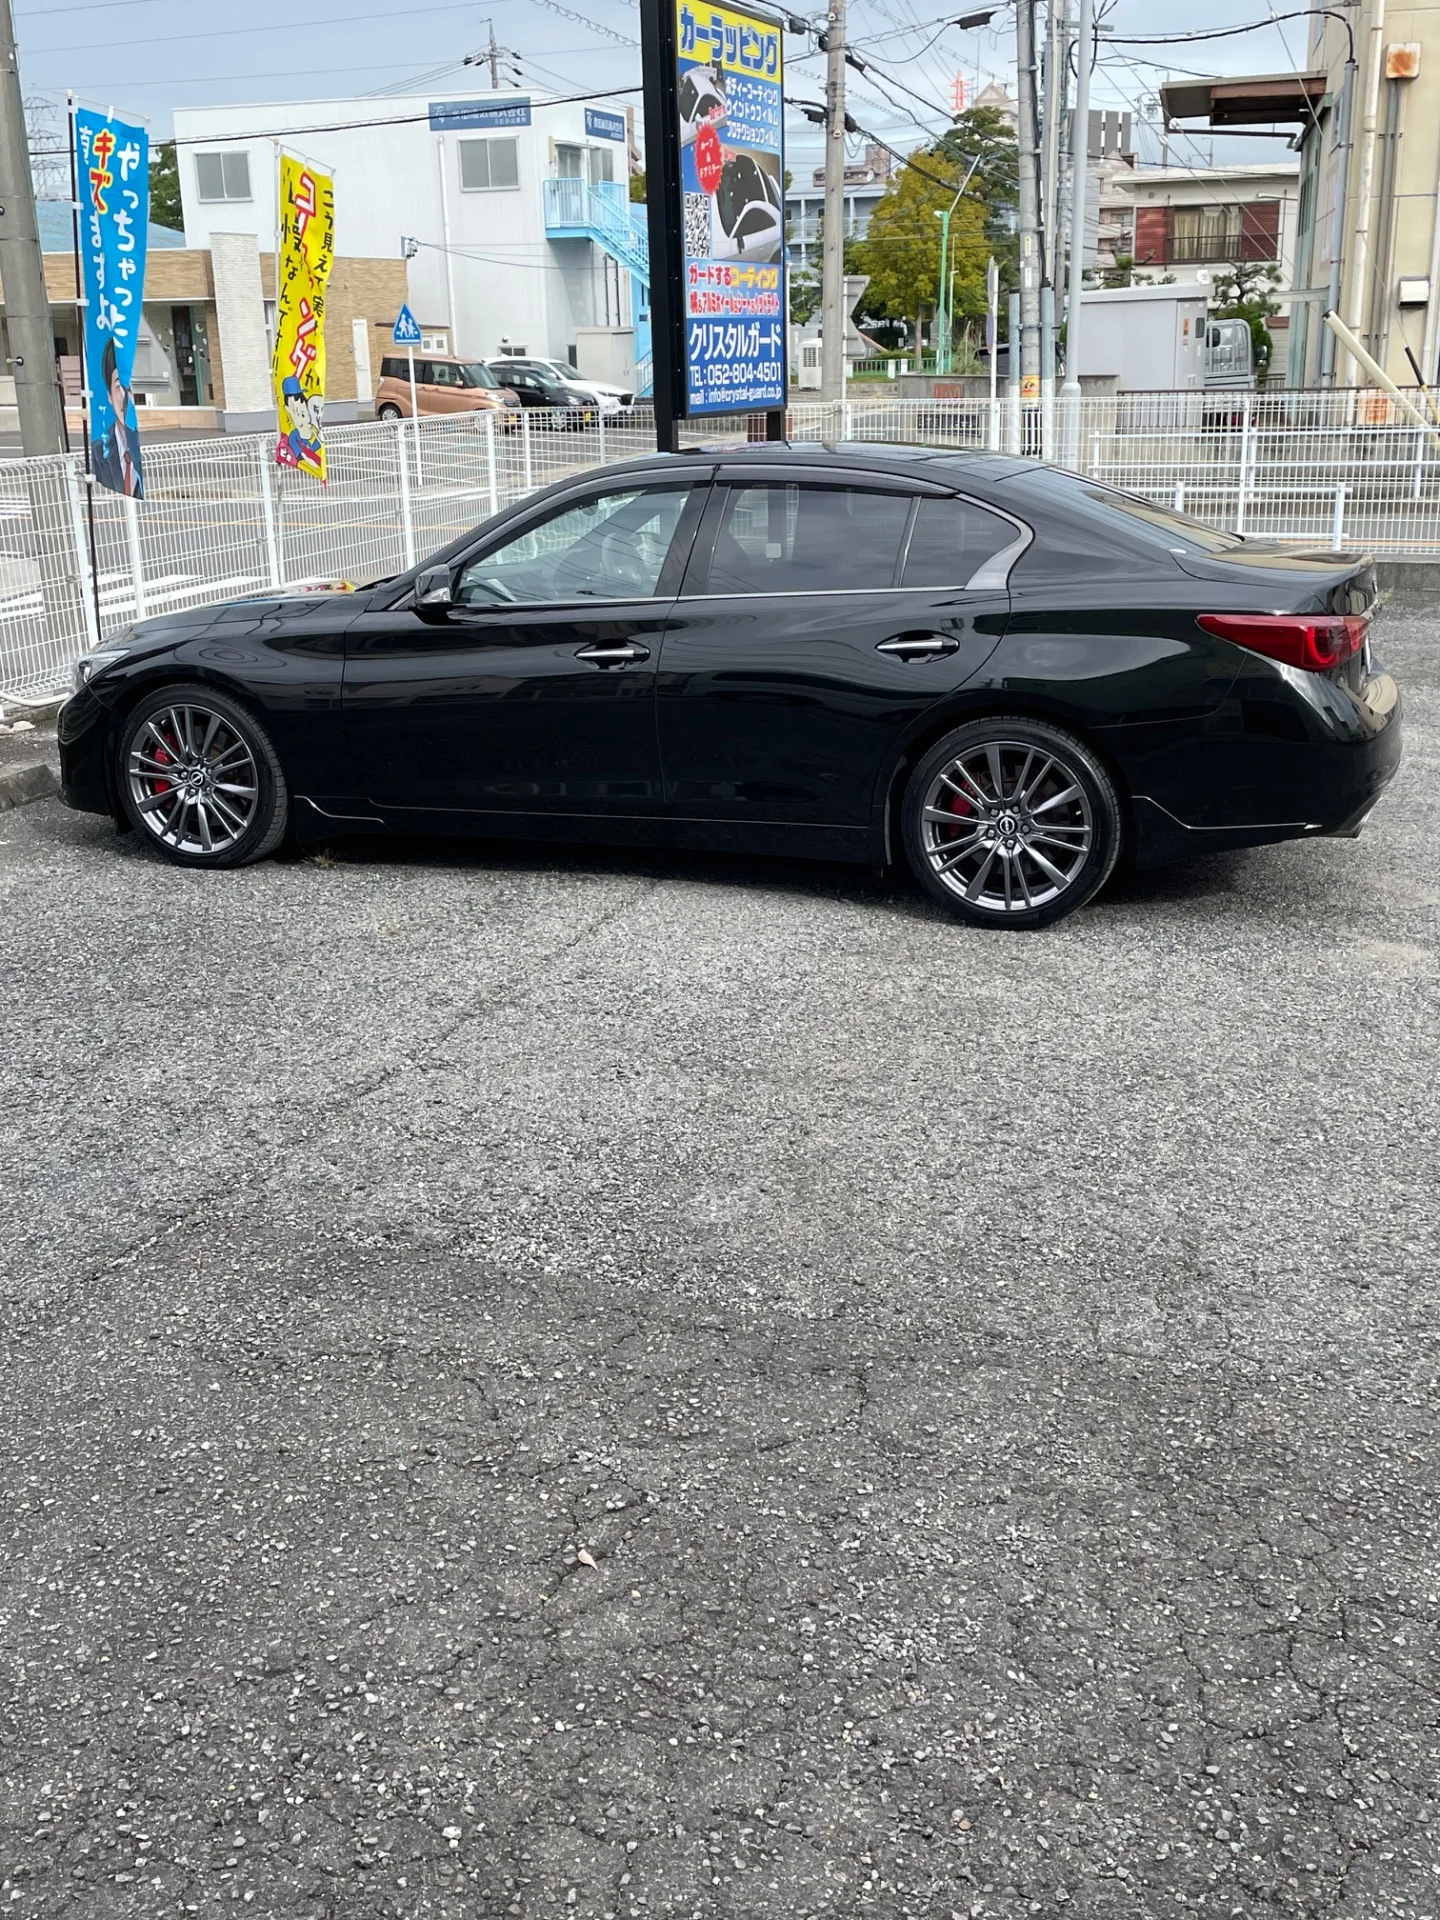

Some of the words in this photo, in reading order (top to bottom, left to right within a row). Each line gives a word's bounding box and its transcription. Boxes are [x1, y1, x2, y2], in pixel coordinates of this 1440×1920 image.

[680, 6, 778, 77] カーラッピング
[725, 76, 778, 106] ボディーコーティング
[727, 120, 778, 147] プロテクションフィルム
[90, 128, 117, 215] キズ
[699, 164, 720, 179] ドアミラー
[110, 141, 141, 349] やっちゃった
[689, 321, 782, 362] クリスタルガード
